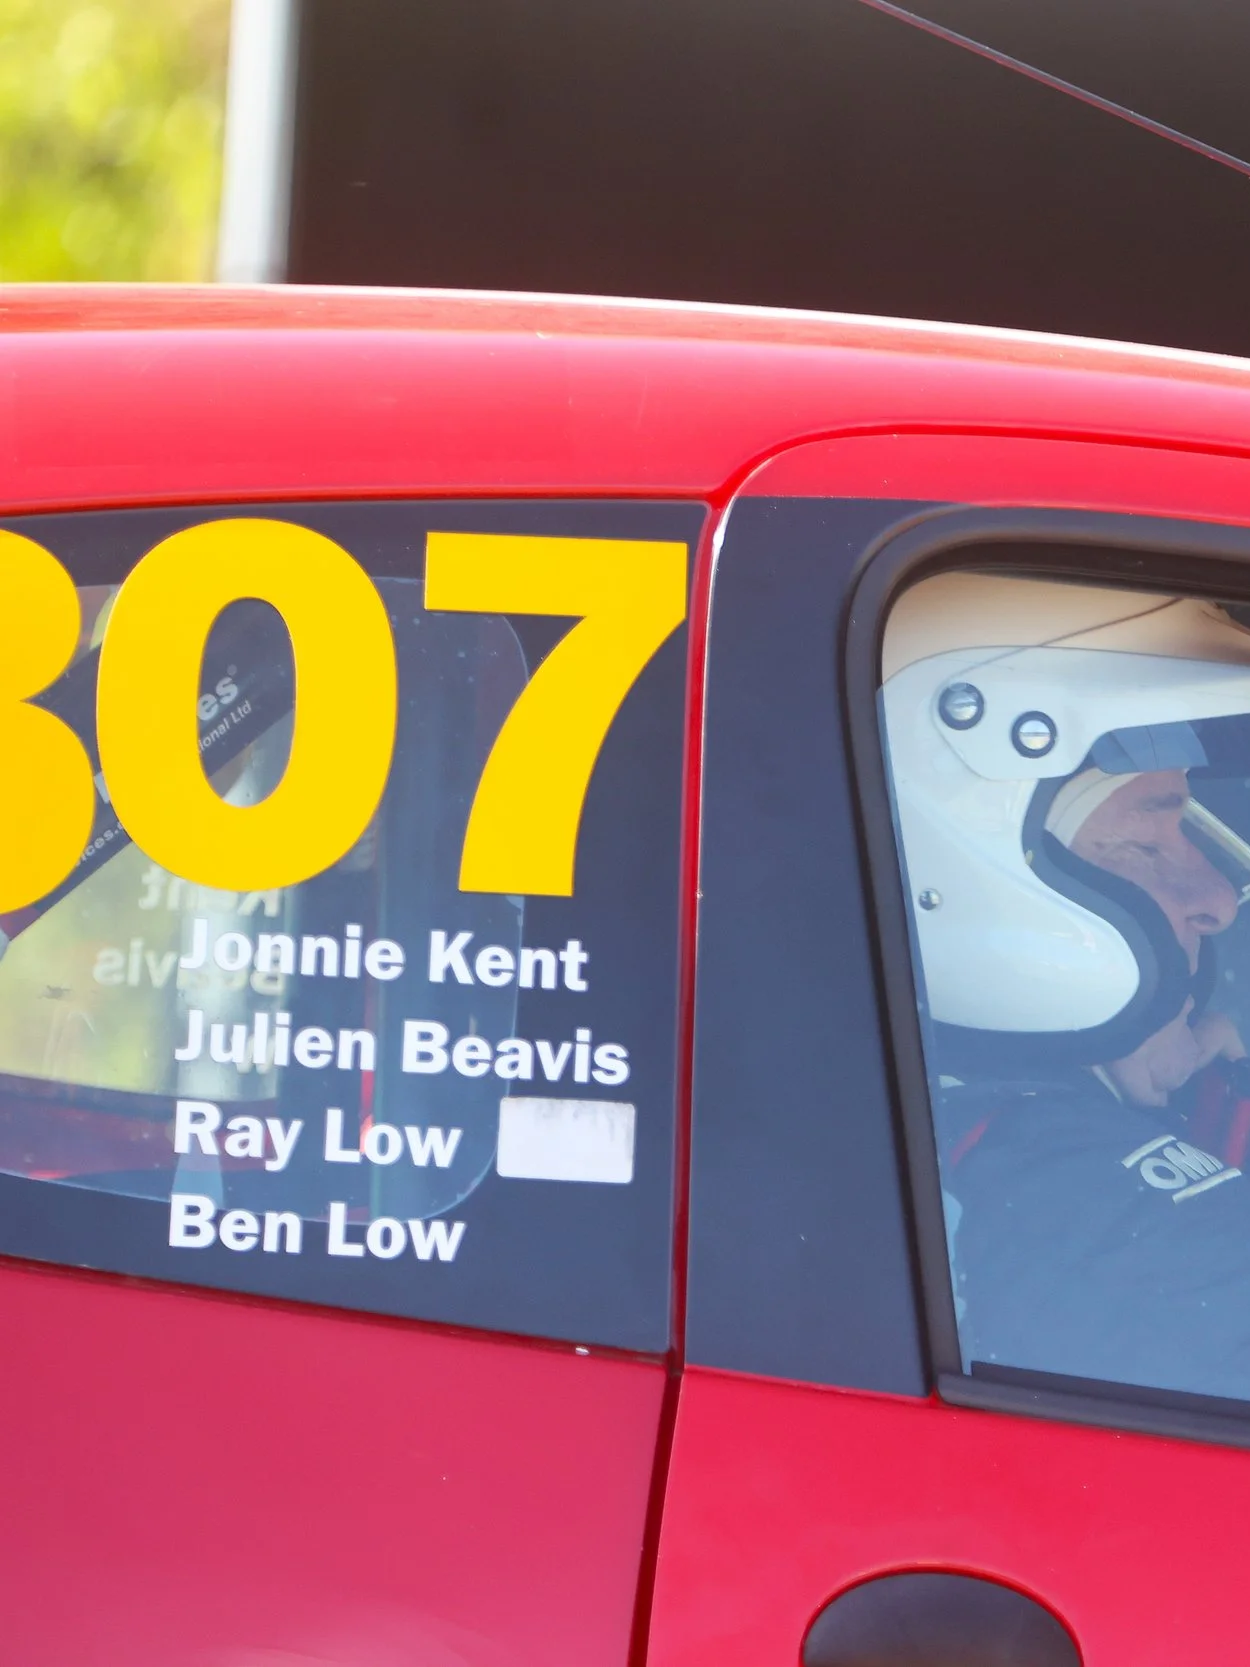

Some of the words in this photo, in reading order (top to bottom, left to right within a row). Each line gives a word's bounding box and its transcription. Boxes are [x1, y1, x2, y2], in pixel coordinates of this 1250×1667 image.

[179, 917, 407, 981] Jonnie
[428, 930, 588, 992] Kent
[174, 1008, 375, 1071] Julien
[401, 1019, 629, 1086] Beavis
[173, 1101, 303, 1172] Ray
[324, 1109, 462, 1169] Low
[169, 1194, 301, 1254] Ben
[328, 1202, 466, 1263] Low
